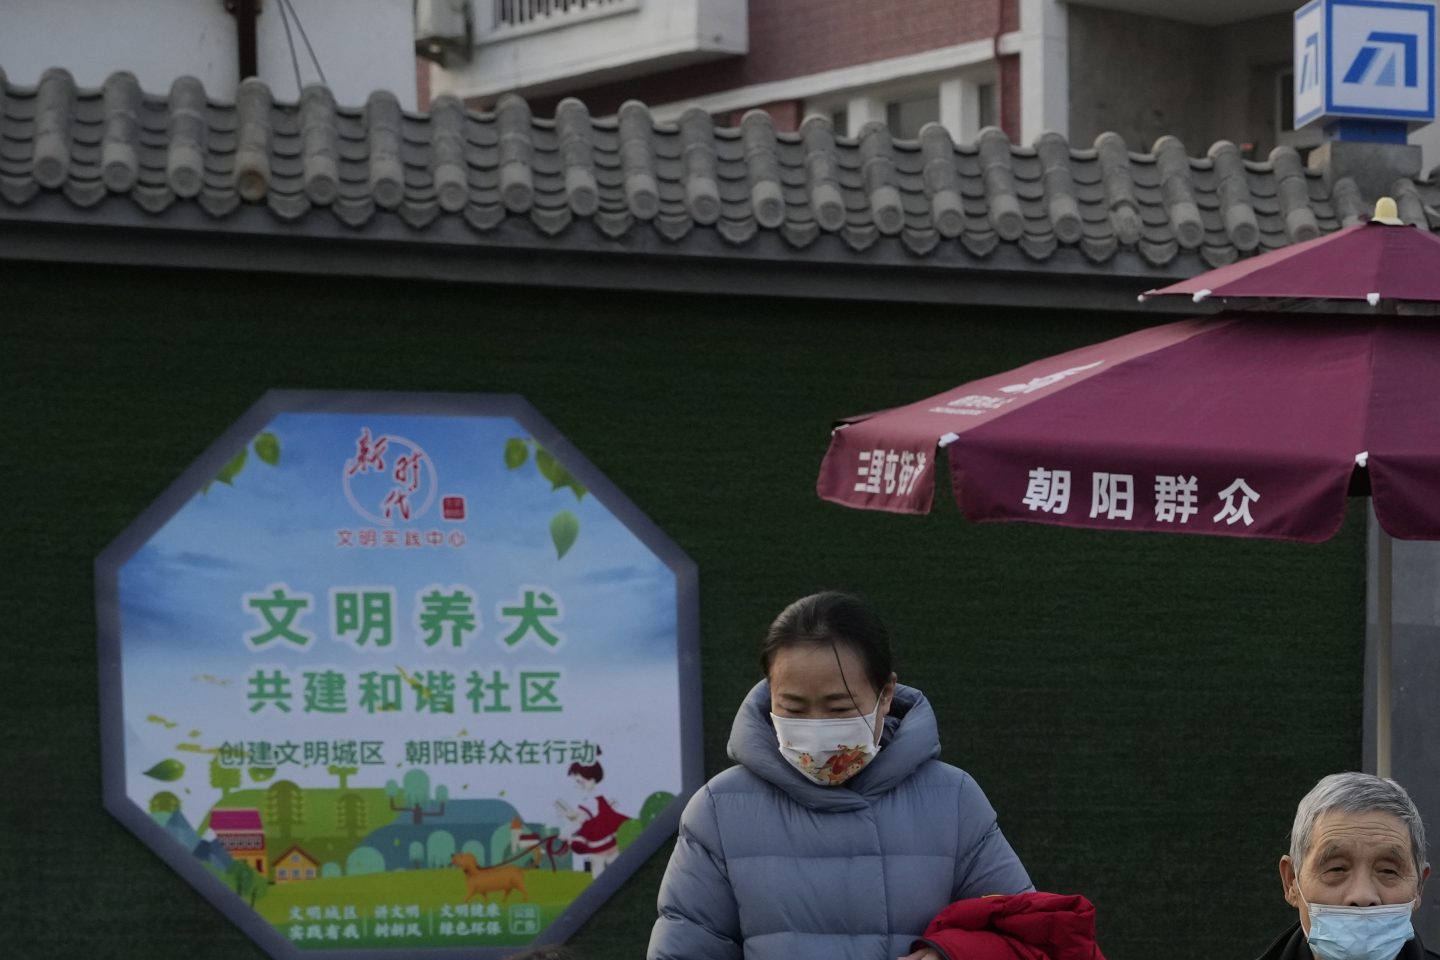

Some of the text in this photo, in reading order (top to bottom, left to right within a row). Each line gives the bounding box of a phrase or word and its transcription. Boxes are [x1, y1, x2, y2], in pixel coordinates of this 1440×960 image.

[1022, 466, 1261, 526] 朝阳群众
[337, 529, 466, 547] 文明实践中心
[247, 588, 562, 648] 文明养犬
[247, 669, 564, 715] 共建和谐社区
[219, 738, 596, 767] 创建文明城区 朝阳群众在行动
